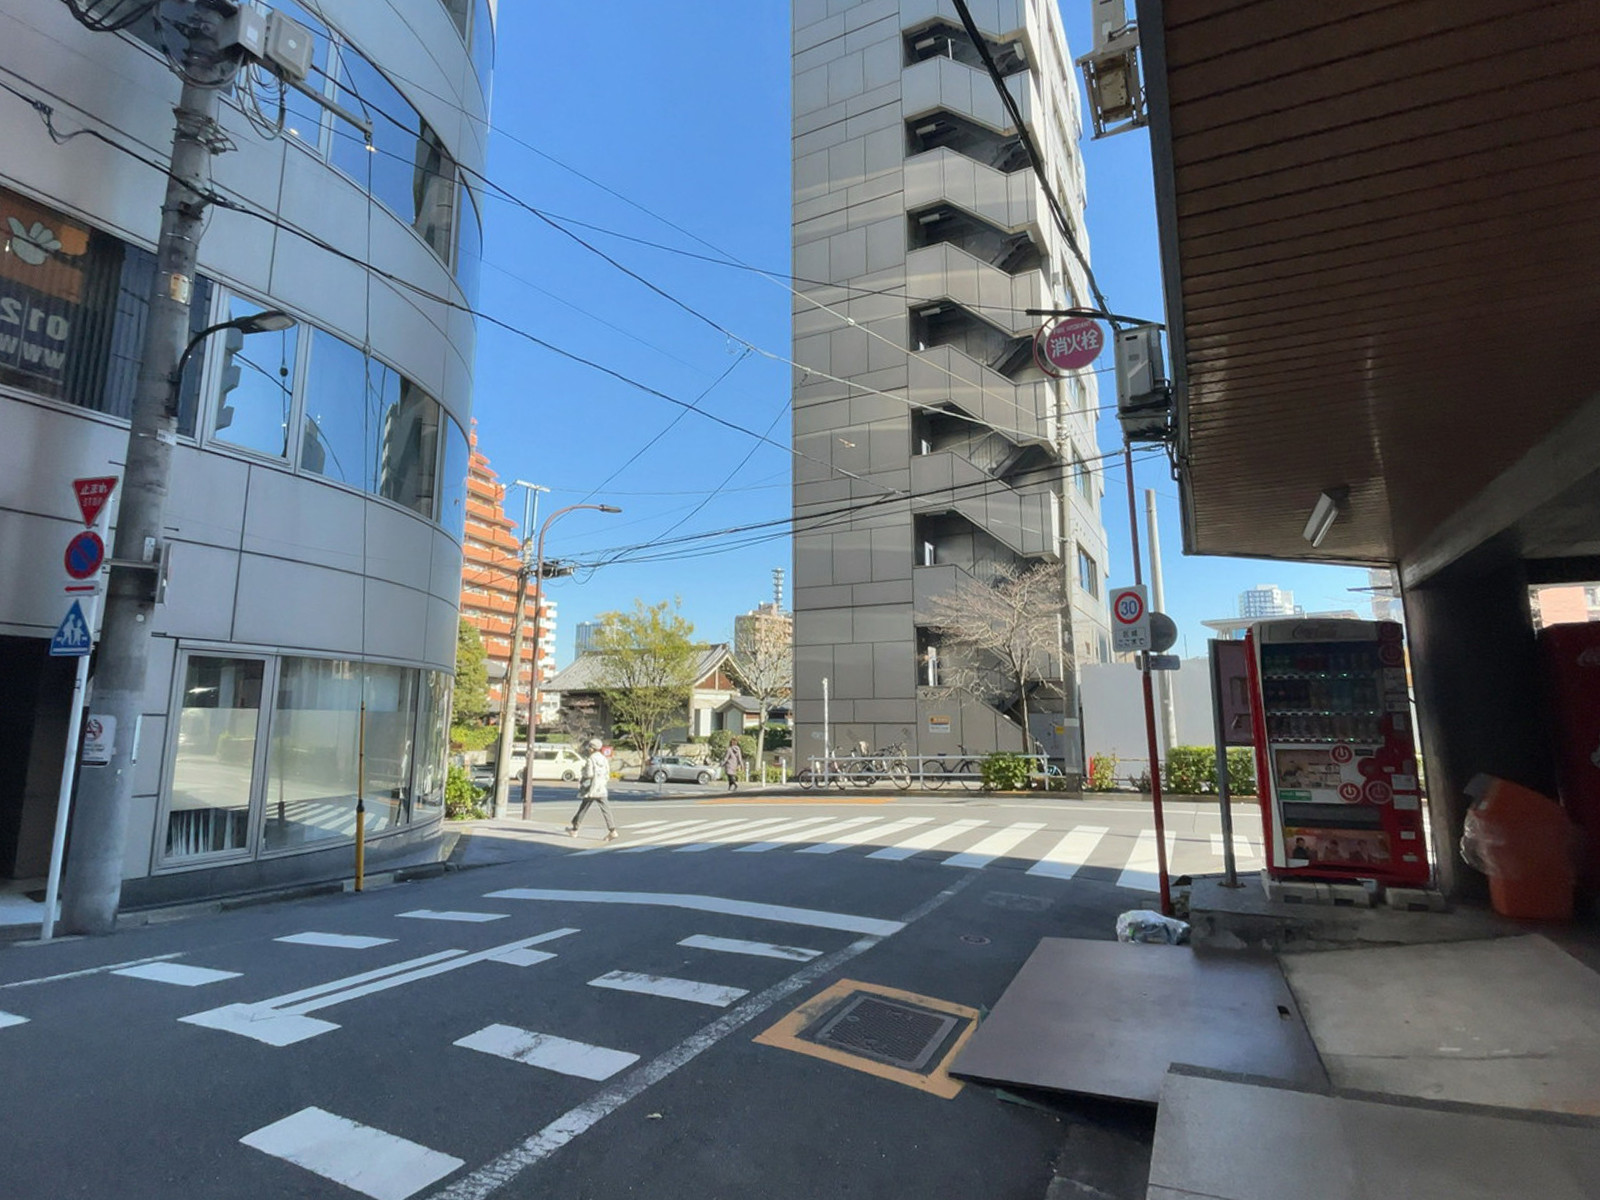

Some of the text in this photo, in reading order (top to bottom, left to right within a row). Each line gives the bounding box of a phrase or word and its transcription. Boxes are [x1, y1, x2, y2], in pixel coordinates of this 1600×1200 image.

[1050, 329, 1099, 359] 消火栓
[80, 482, 108, 495] 止まれ
[1120, 600, 1138, 616] 30
